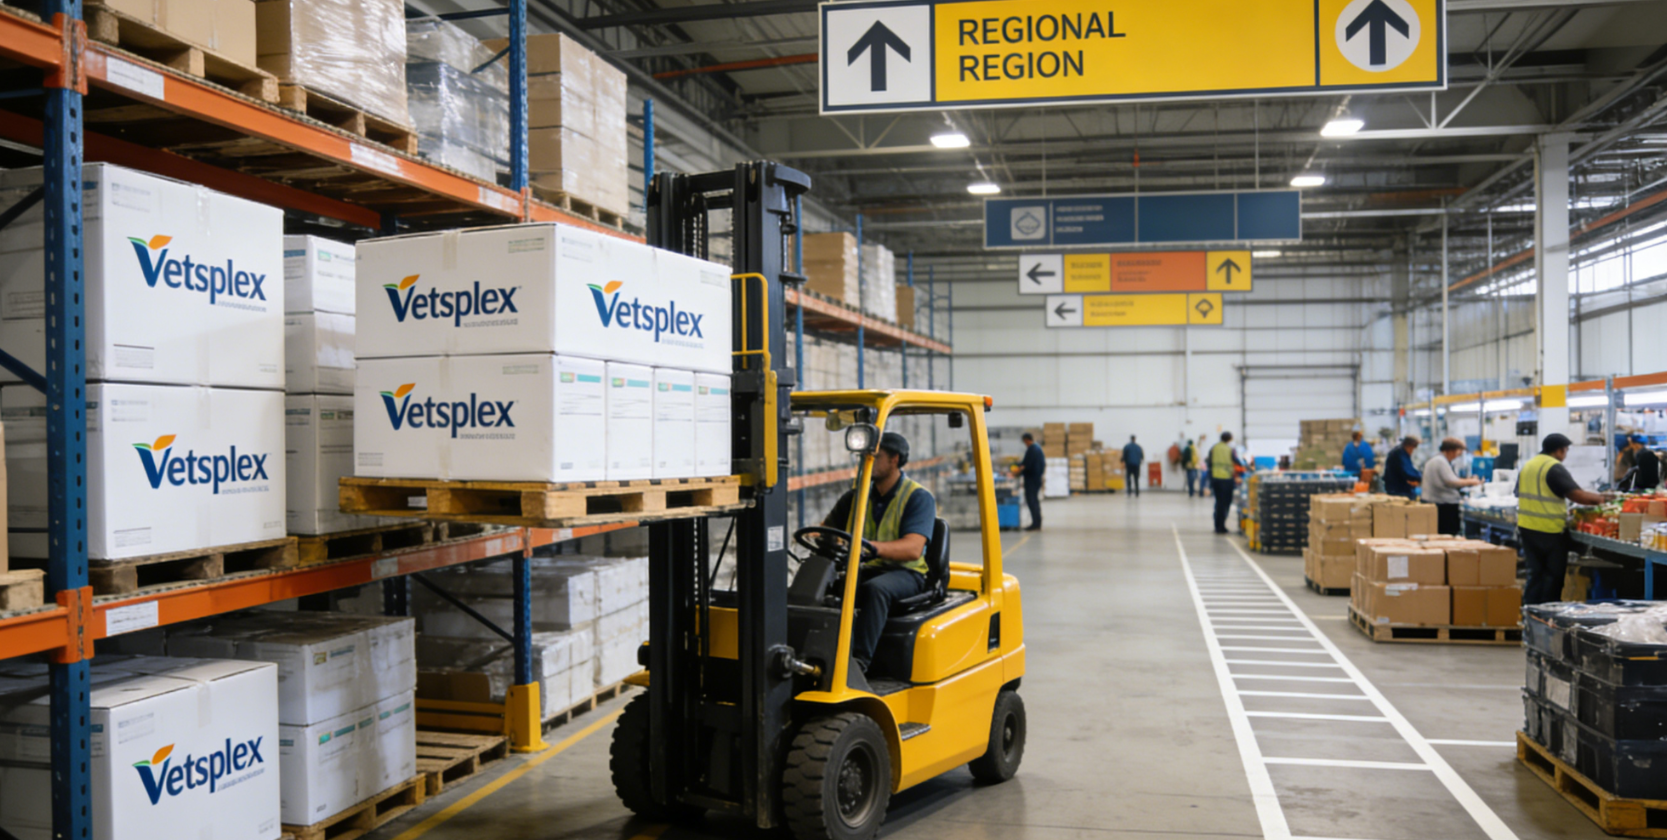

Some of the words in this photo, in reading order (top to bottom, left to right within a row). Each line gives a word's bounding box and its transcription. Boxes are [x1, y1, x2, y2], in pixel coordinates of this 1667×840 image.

[958, 11, 1126, 46] REGIONAL
[959, 50, 1084, 82] REGION
[127, 234, 267, 305] Vetsplex
[383, 274, 518, 327] Vetsplex
[587, 280, 704, 342] Vetsplex
[380, 383, 515, 438] Vetsplex
[132, 434, 268, 494] Vetsplex
[132, 735, 264, 805] Vetsplex
